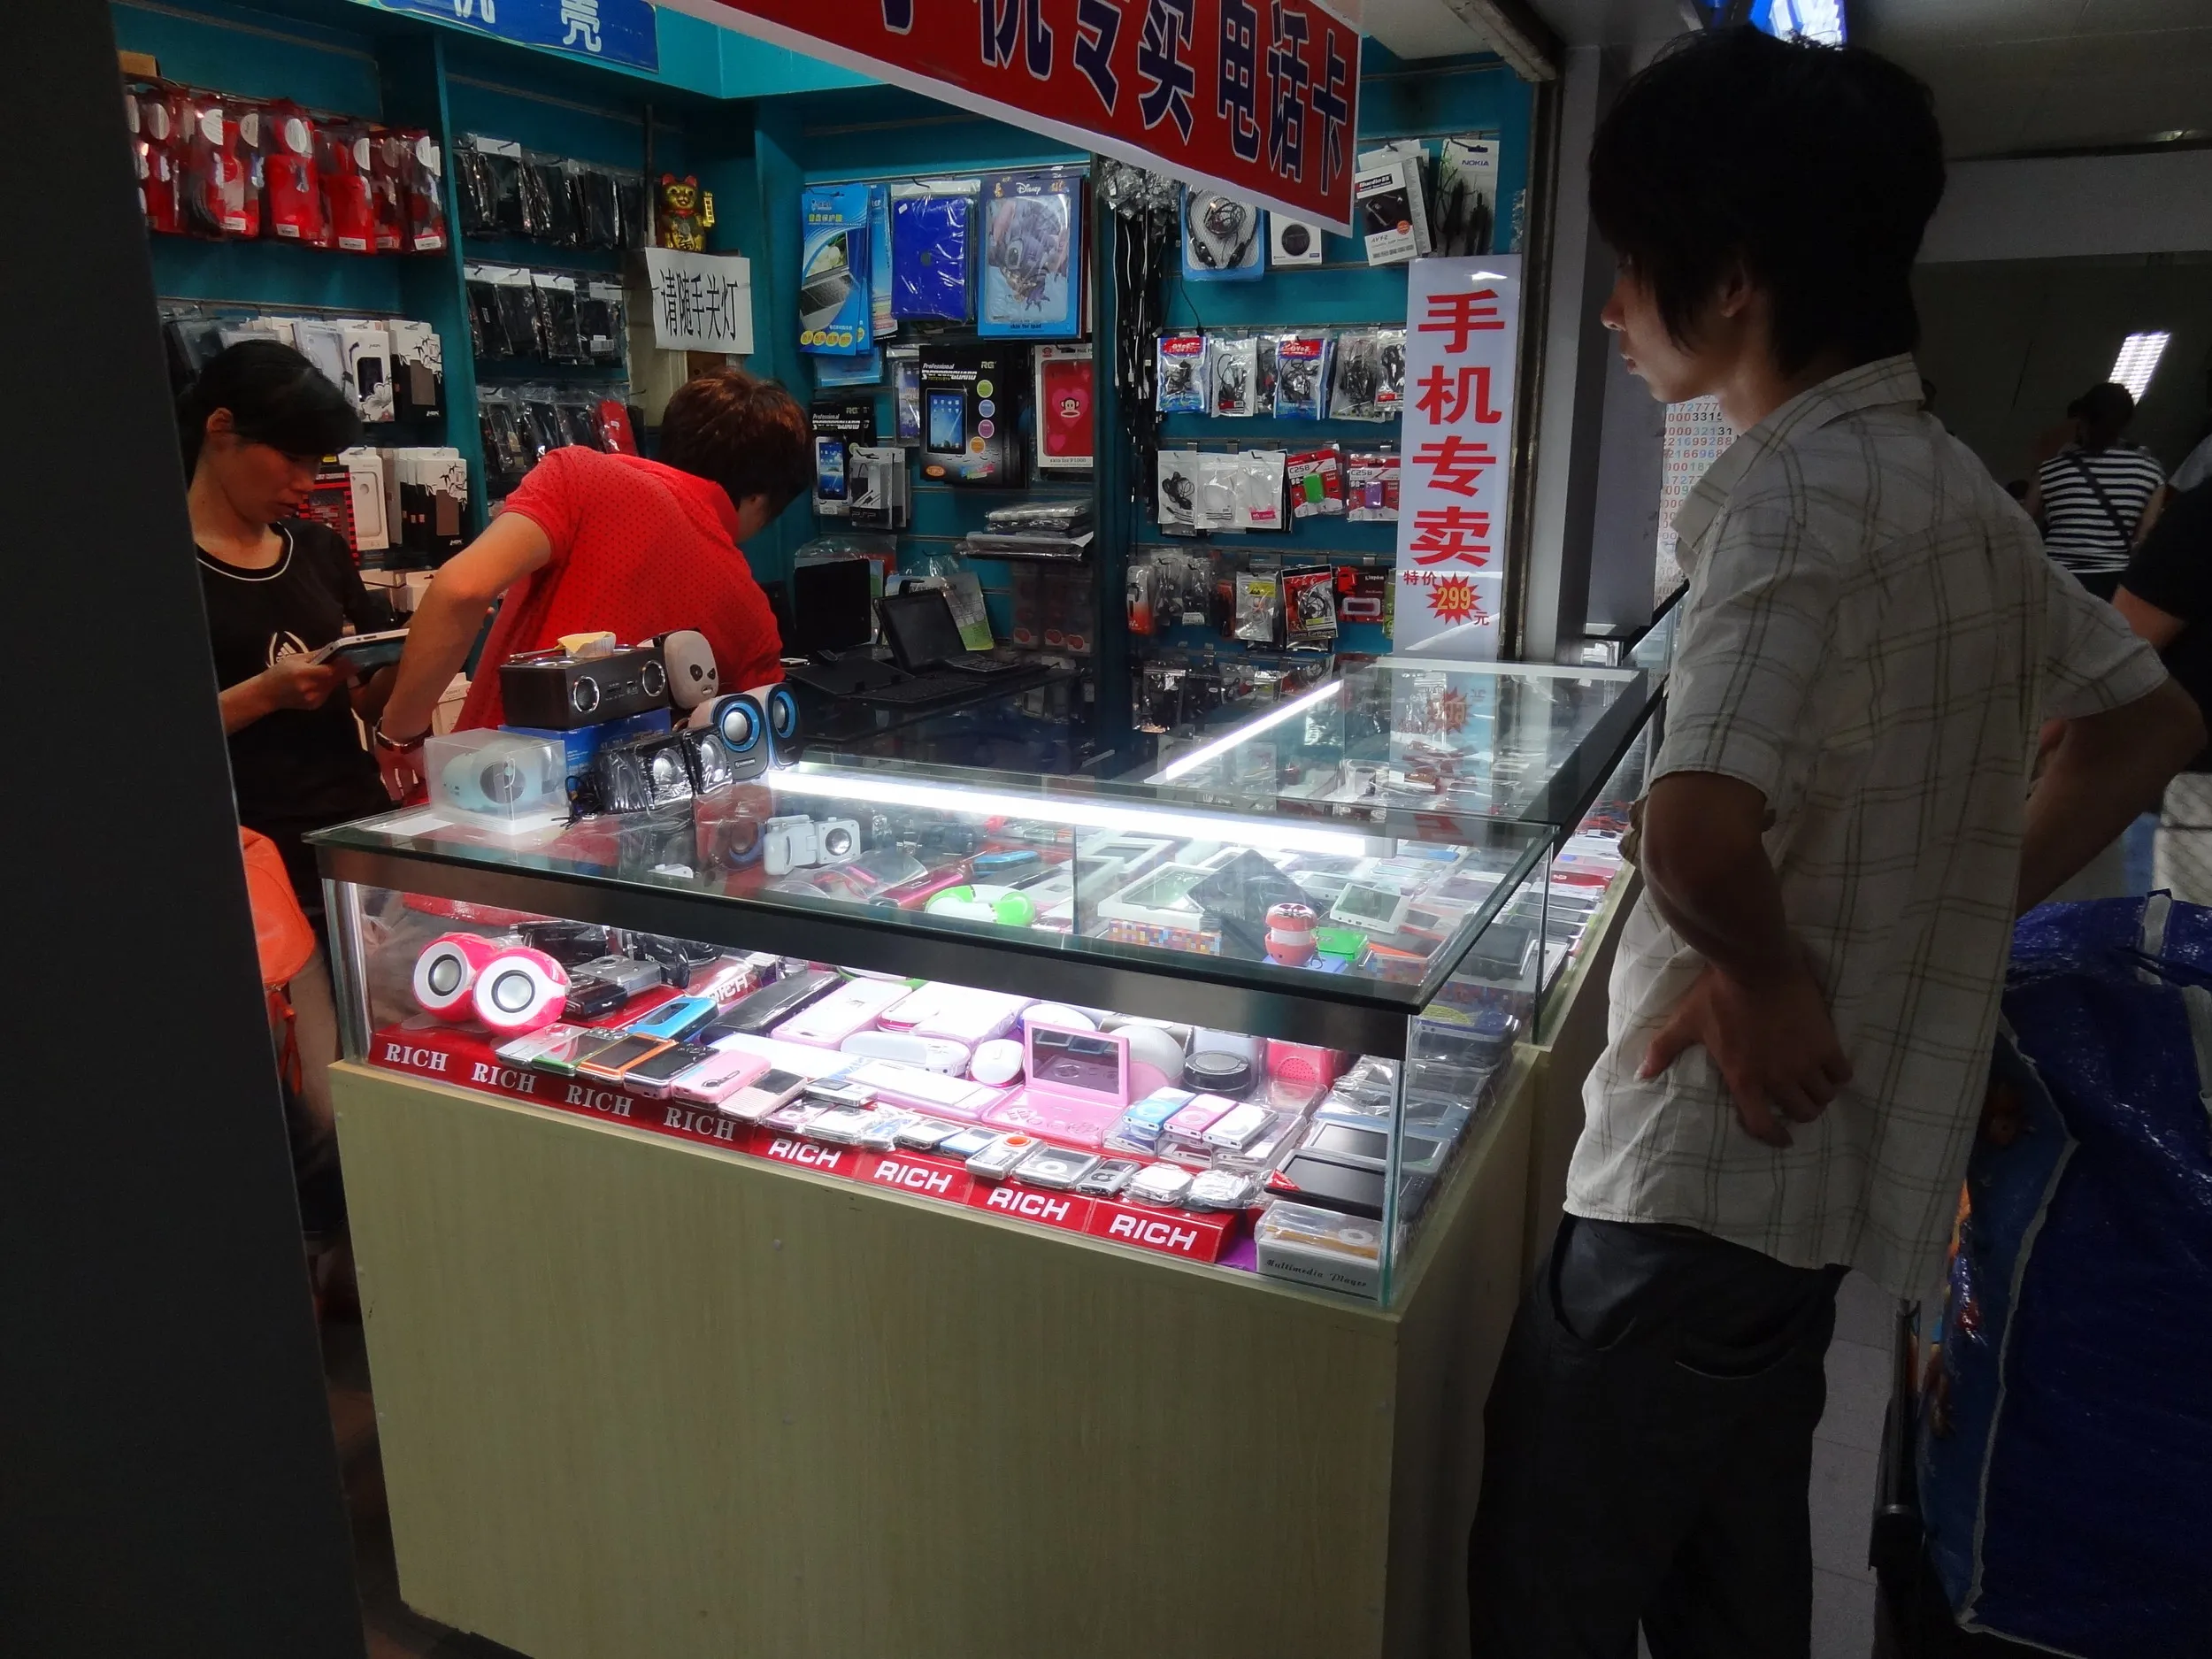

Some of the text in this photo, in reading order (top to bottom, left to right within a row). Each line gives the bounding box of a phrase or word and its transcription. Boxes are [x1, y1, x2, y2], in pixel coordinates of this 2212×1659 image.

[1016, 181, 1042, 195] Disney
[660, 268, 739, 342] 请随手关灯
[1409, 288, 1506, 567] 手机专卖
[1403, 569, 1490, 626] 特价 299 元
[385, 1043, 449, 1071] RICH
[472, 1063, 536, 1094] RICH
[565, 1084, 634, 1118] RICH
[664, 1107, 737, 1141] RICH
[768, 1139, 841, 1169] RICH
[874, 1161, 953, 1194] RICH
[987, 1187, 1071, 1221] RICH
[1109, 1214, 1198, 1251] RICH
